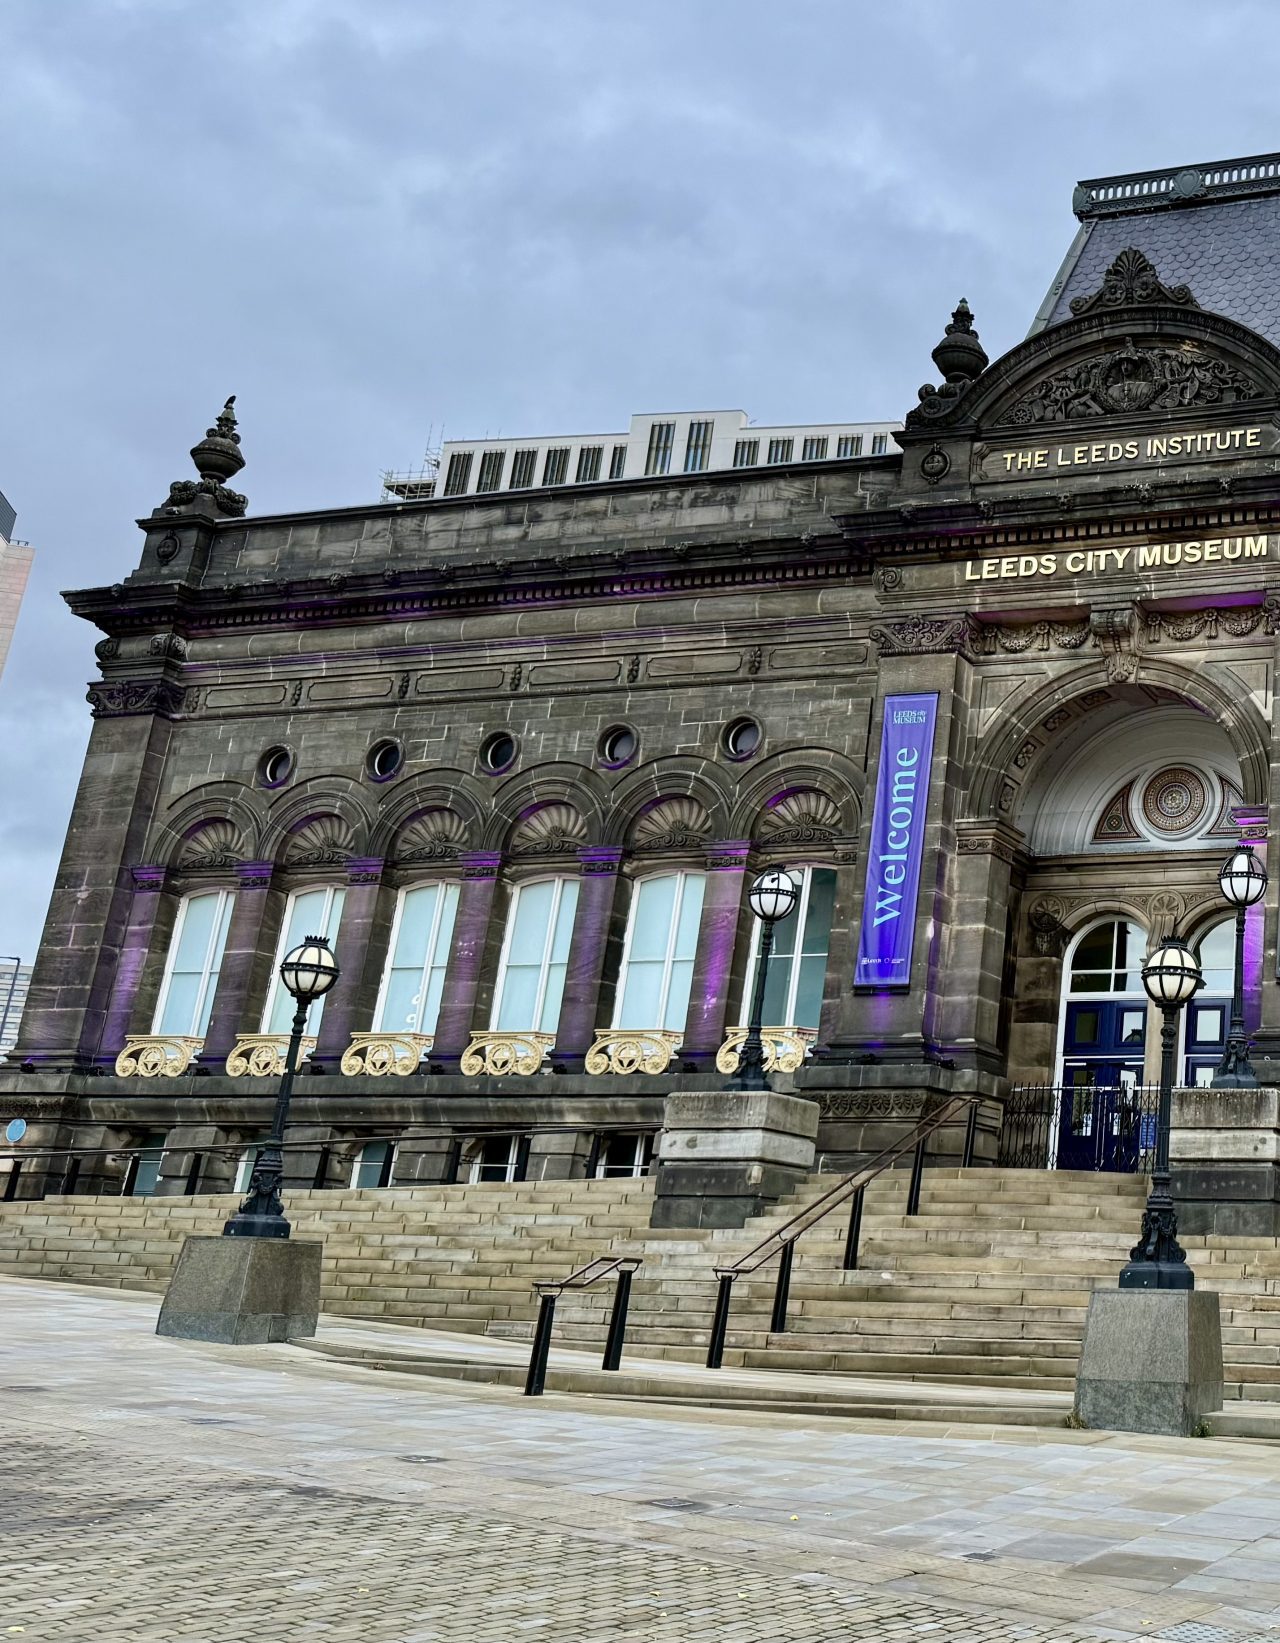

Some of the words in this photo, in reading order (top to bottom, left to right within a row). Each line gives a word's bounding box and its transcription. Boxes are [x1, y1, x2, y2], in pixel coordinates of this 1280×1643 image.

[1003, 450, 1048, 471] THE
[1057, 441, 1138, 466] LEEDS
[1147, 428, 1261, 457] INSTITUTE
[965, 554, 1057, 581] LEEDS
[1065, 547, 1132, 573] CITY
[1138, 535, 1268, 568] MUSEUM
[893, 716, 926, 724] MUSEUM
[872, 747, 919, 928] Welcome
